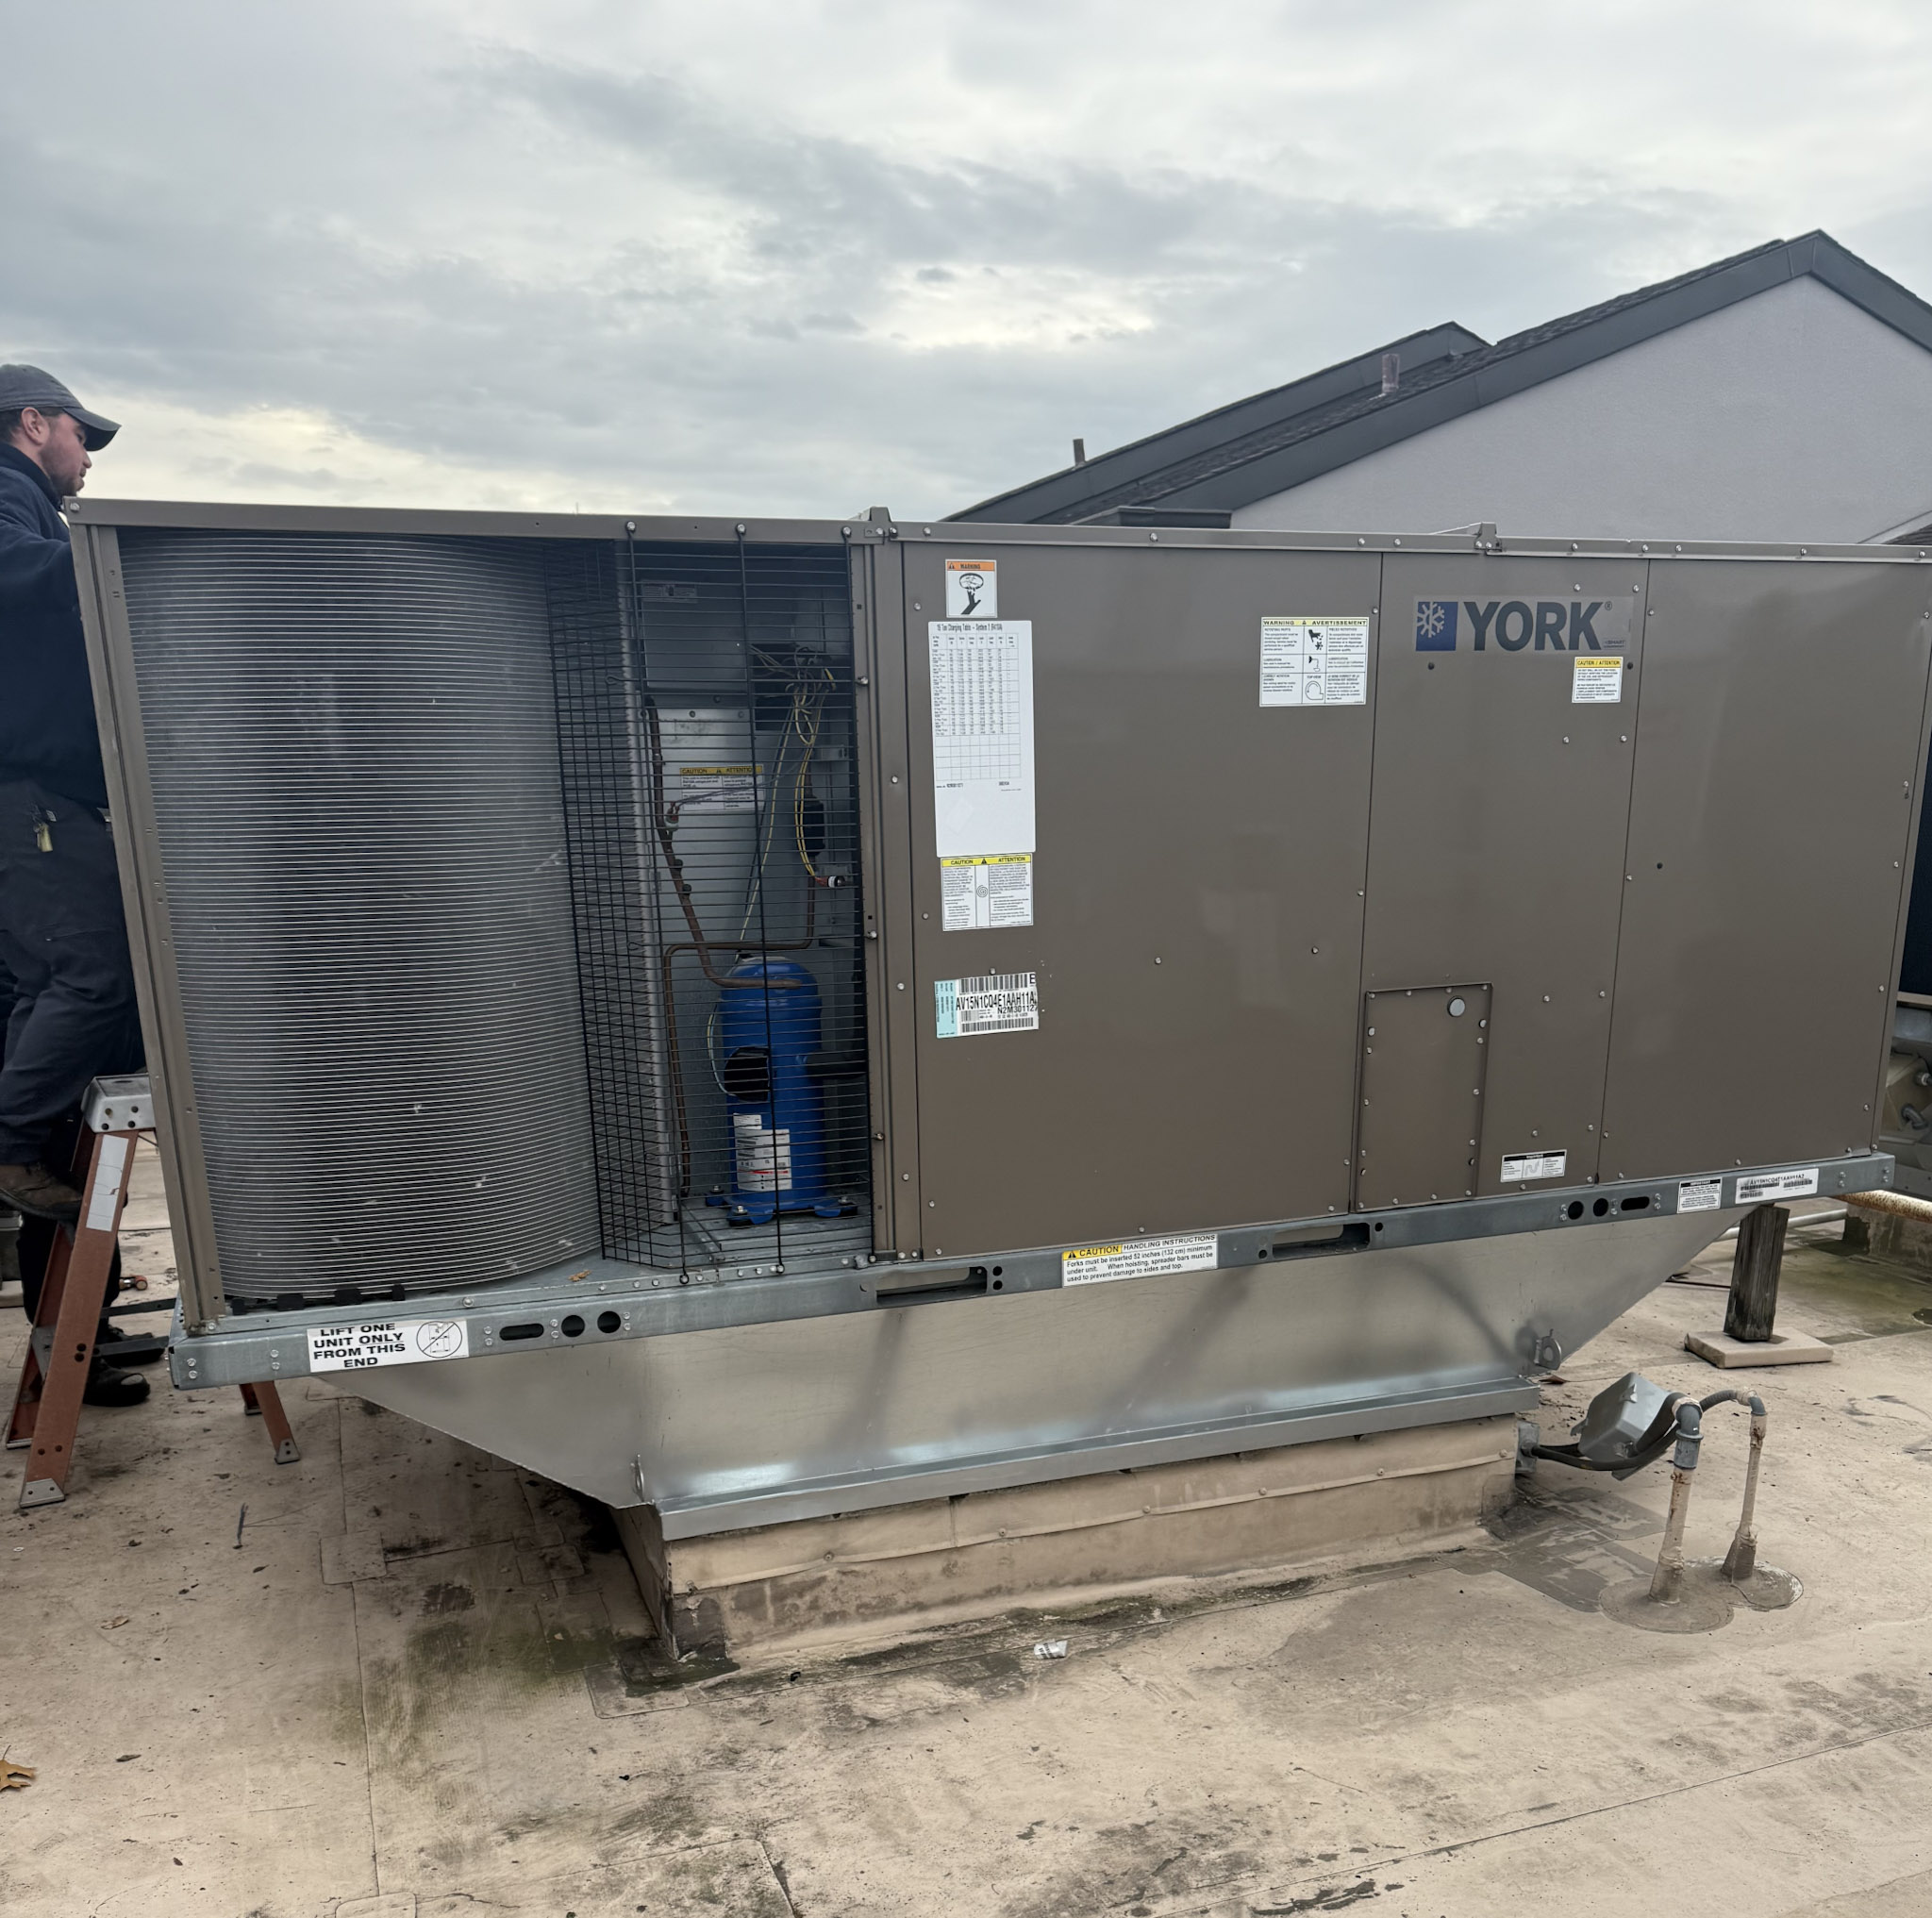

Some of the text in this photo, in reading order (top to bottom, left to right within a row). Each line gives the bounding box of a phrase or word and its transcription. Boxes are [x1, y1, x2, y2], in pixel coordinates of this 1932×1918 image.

[1464, 601, 1603, 651] YORK
[1079, 1234, 1215, 1257] CAUTION HANDLING INSTRUCTIONS
[1109, 1254, 1132, 1262] inserted
[1162, 1249, 1174, 1258] (132
[1175, 1247, 1186, 1256] cm)
[1187, 1244, 1212, 1253] minimum
[1067, 1267, 1084, 1276] under
[1124, 1259, 1150, 1269] hoisting,
[1151, 1257, 1175, 1266] spreader
[1090, 1272, 1112, 1280] prevent
[1113, 1269, 1135, 1278] damage
[1172, 1262, 1182, 1271] top.
[320, 1324, 395, 1337] LIFT ONE
[314, 1333, 404, 1348] UNIT ONLY
[313, 1343, 406, 1359] FROM THIS
[344, 1358, 378, 1368] END
